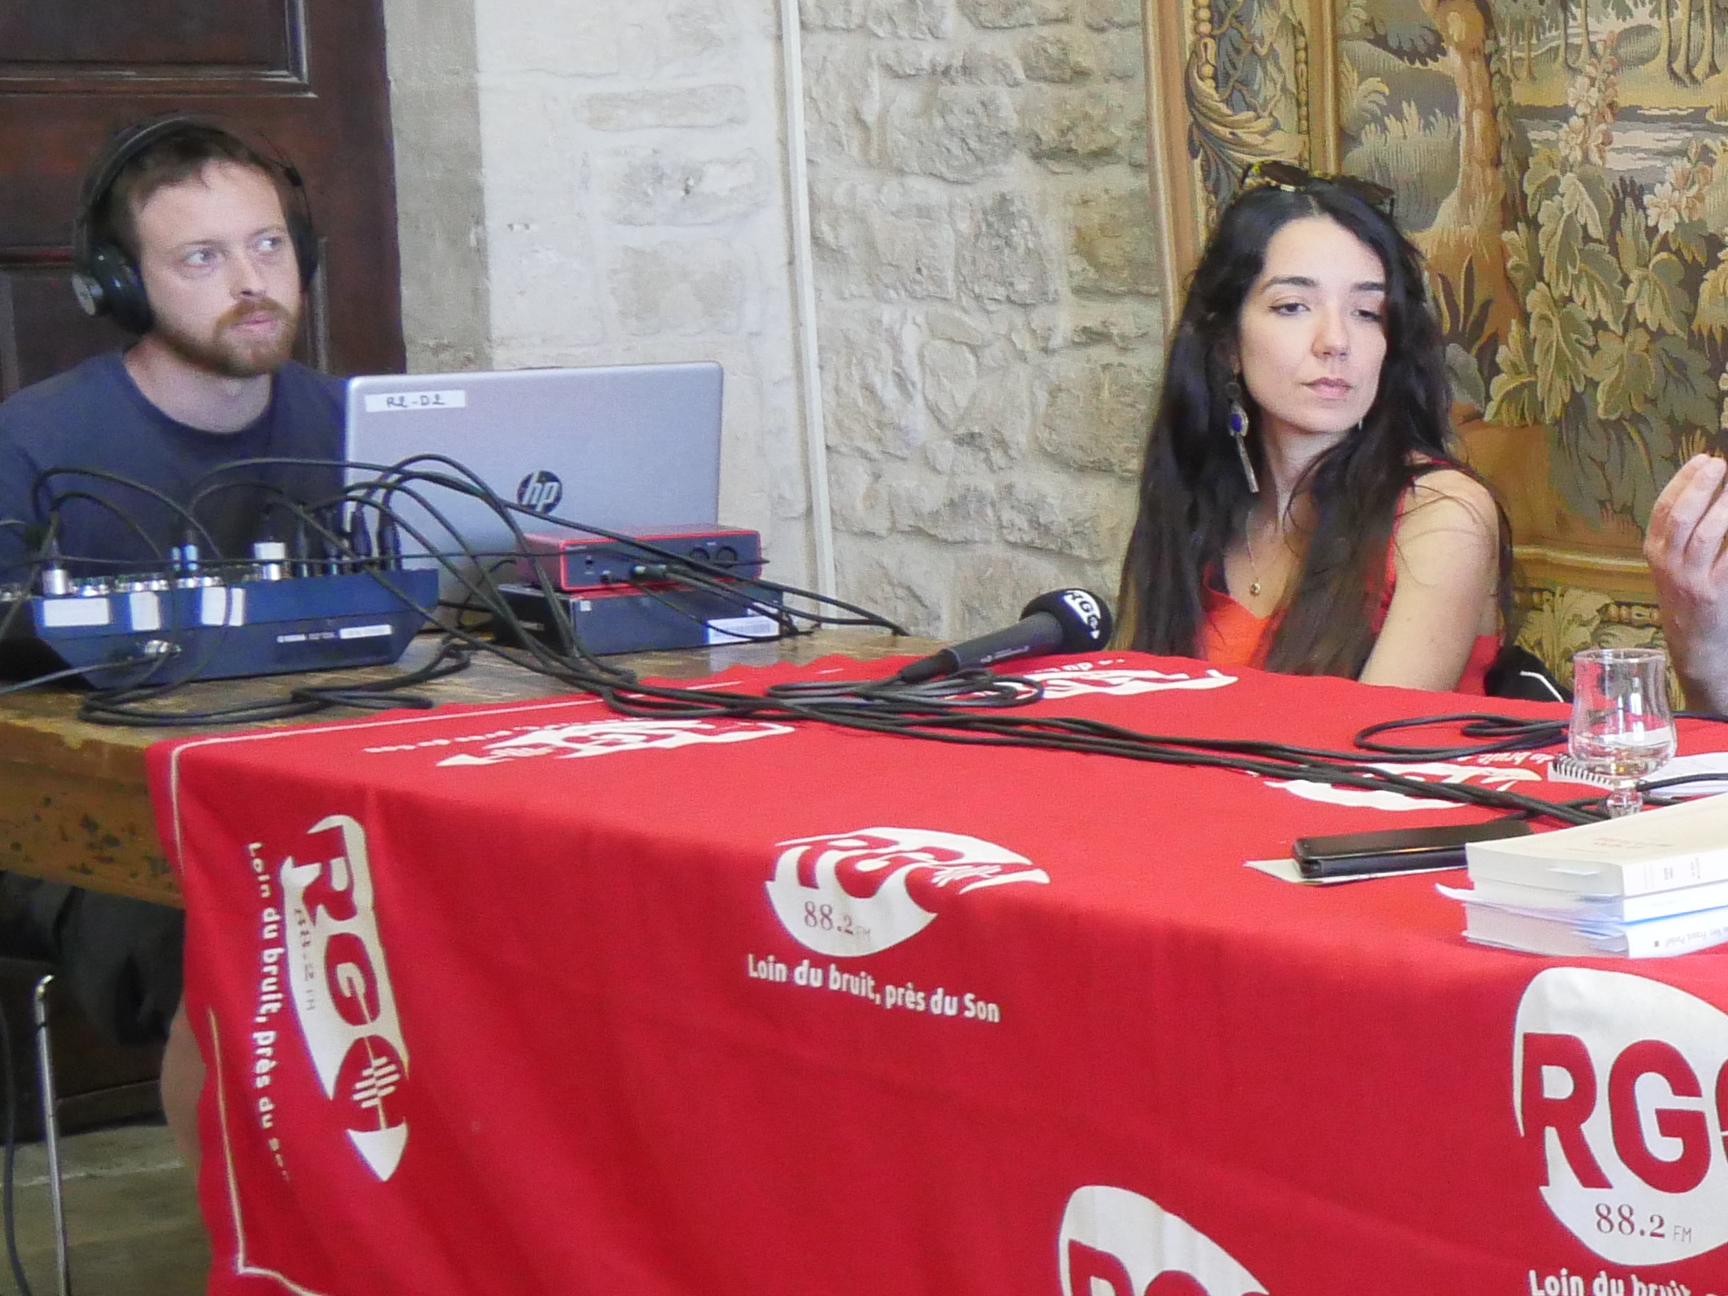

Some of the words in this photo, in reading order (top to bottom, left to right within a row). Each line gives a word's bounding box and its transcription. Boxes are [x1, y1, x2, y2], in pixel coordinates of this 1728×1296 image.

[386, 393, 446, 409] R2-D2
[520, 470, 560, 514] hp
[247, 841, 272, 899] Loin
[261, 907, 283, 940] du
[254, 947, 286, 1025] bruit,
[747, 953, 788, 983] Loin
[794, 959, 824, 988] du
[828, 963, 882, 1005] bruit,
[884, 981, 926, 1010] près
[930, 987, 958, 1017] du
[963, 992, 1002, 1024] Son
[252, 1029, 279, 1091] près
[255, 1093, 275, 1131] du
[1594, 1202, 1666, 1240] 88.2
[1672, 1224, 1693, 1244] FM
